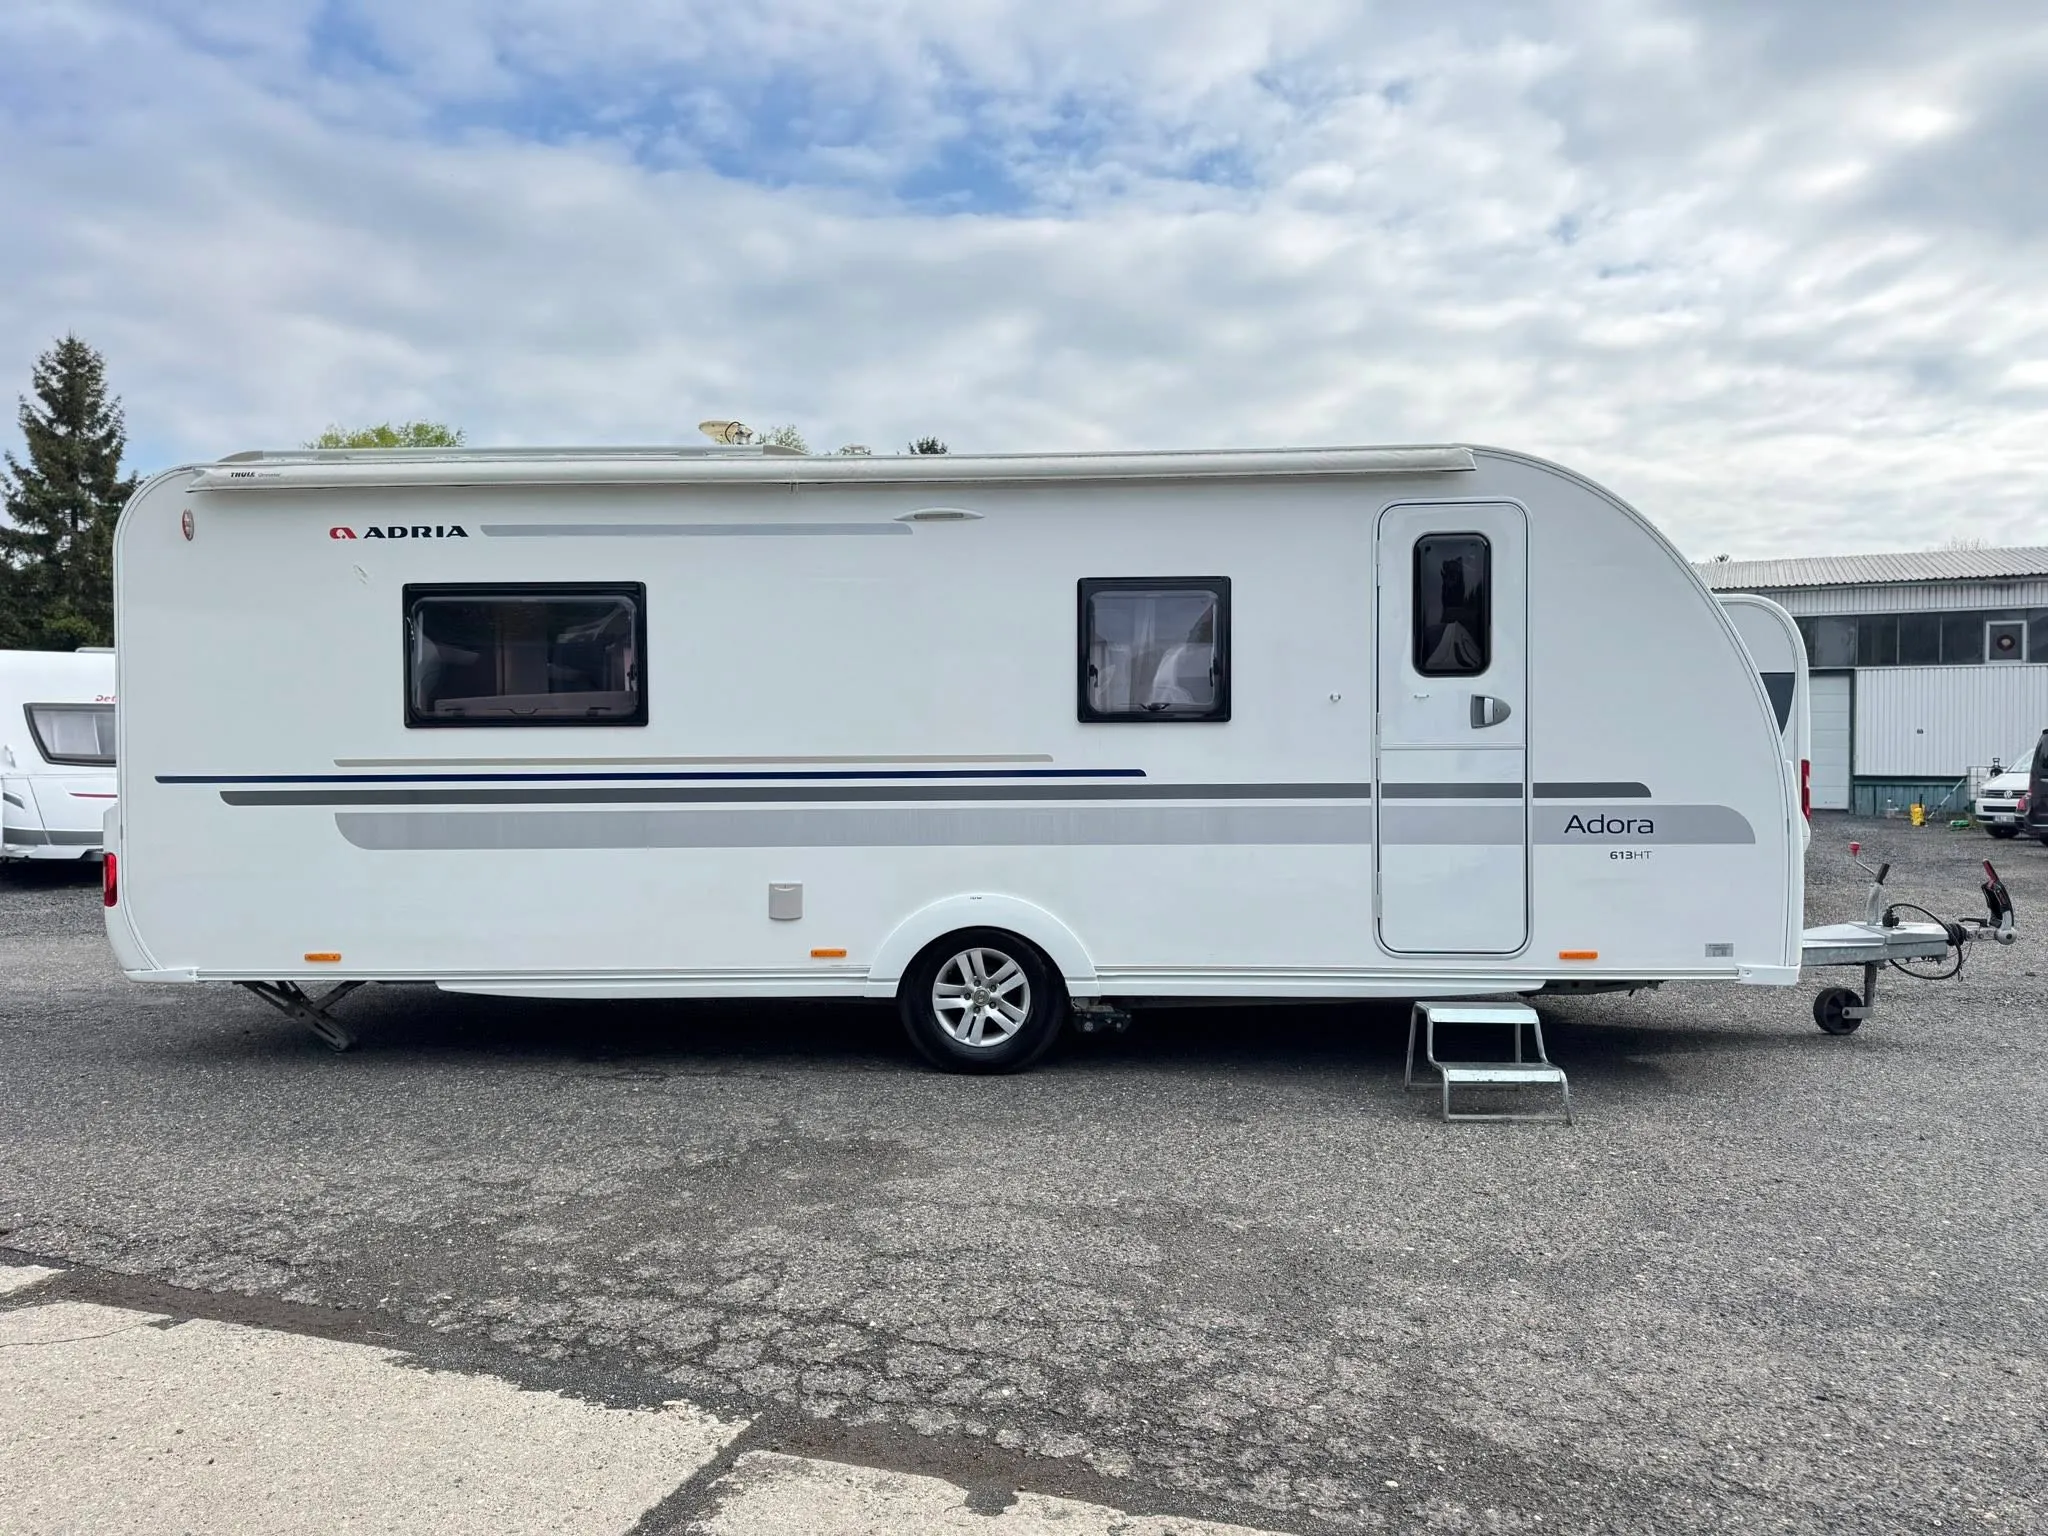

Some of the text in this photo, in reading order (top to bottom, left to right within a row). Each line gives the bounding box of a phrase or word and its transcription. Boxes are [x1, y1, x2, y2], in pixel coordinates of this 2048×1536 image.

[363, 525, 469, 539] ADRIA
[1563, 813, 1654, 834] Adora
[1609, 850, 1652, 860] 613HT
